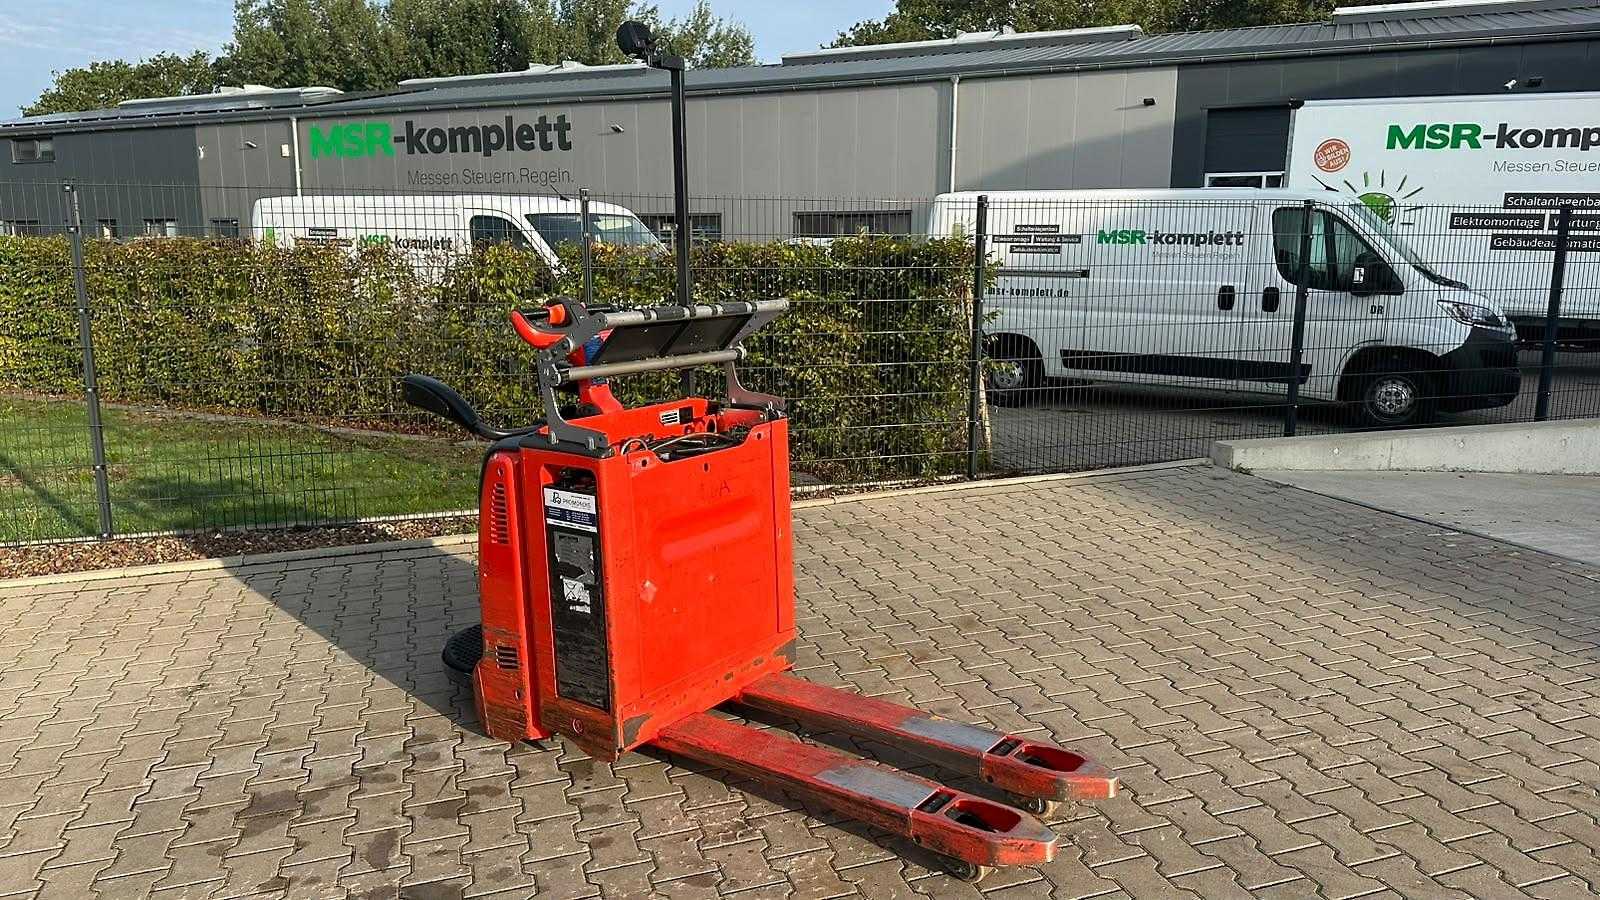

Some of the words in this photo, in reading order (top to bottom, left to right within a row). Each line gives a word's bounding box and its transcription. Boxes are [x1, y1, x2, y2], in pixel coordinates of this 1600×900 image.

[310, 114, 572, 158] MSR-komplett
[1386, 123, 1600, 151] MSR-komp
[408, 167, 574, 186] Messen.Steuern.Regeln.
[1453, 216, 1540, 229] Elektromontage
[1097, 229, 1244, 247] MSR-komplett
